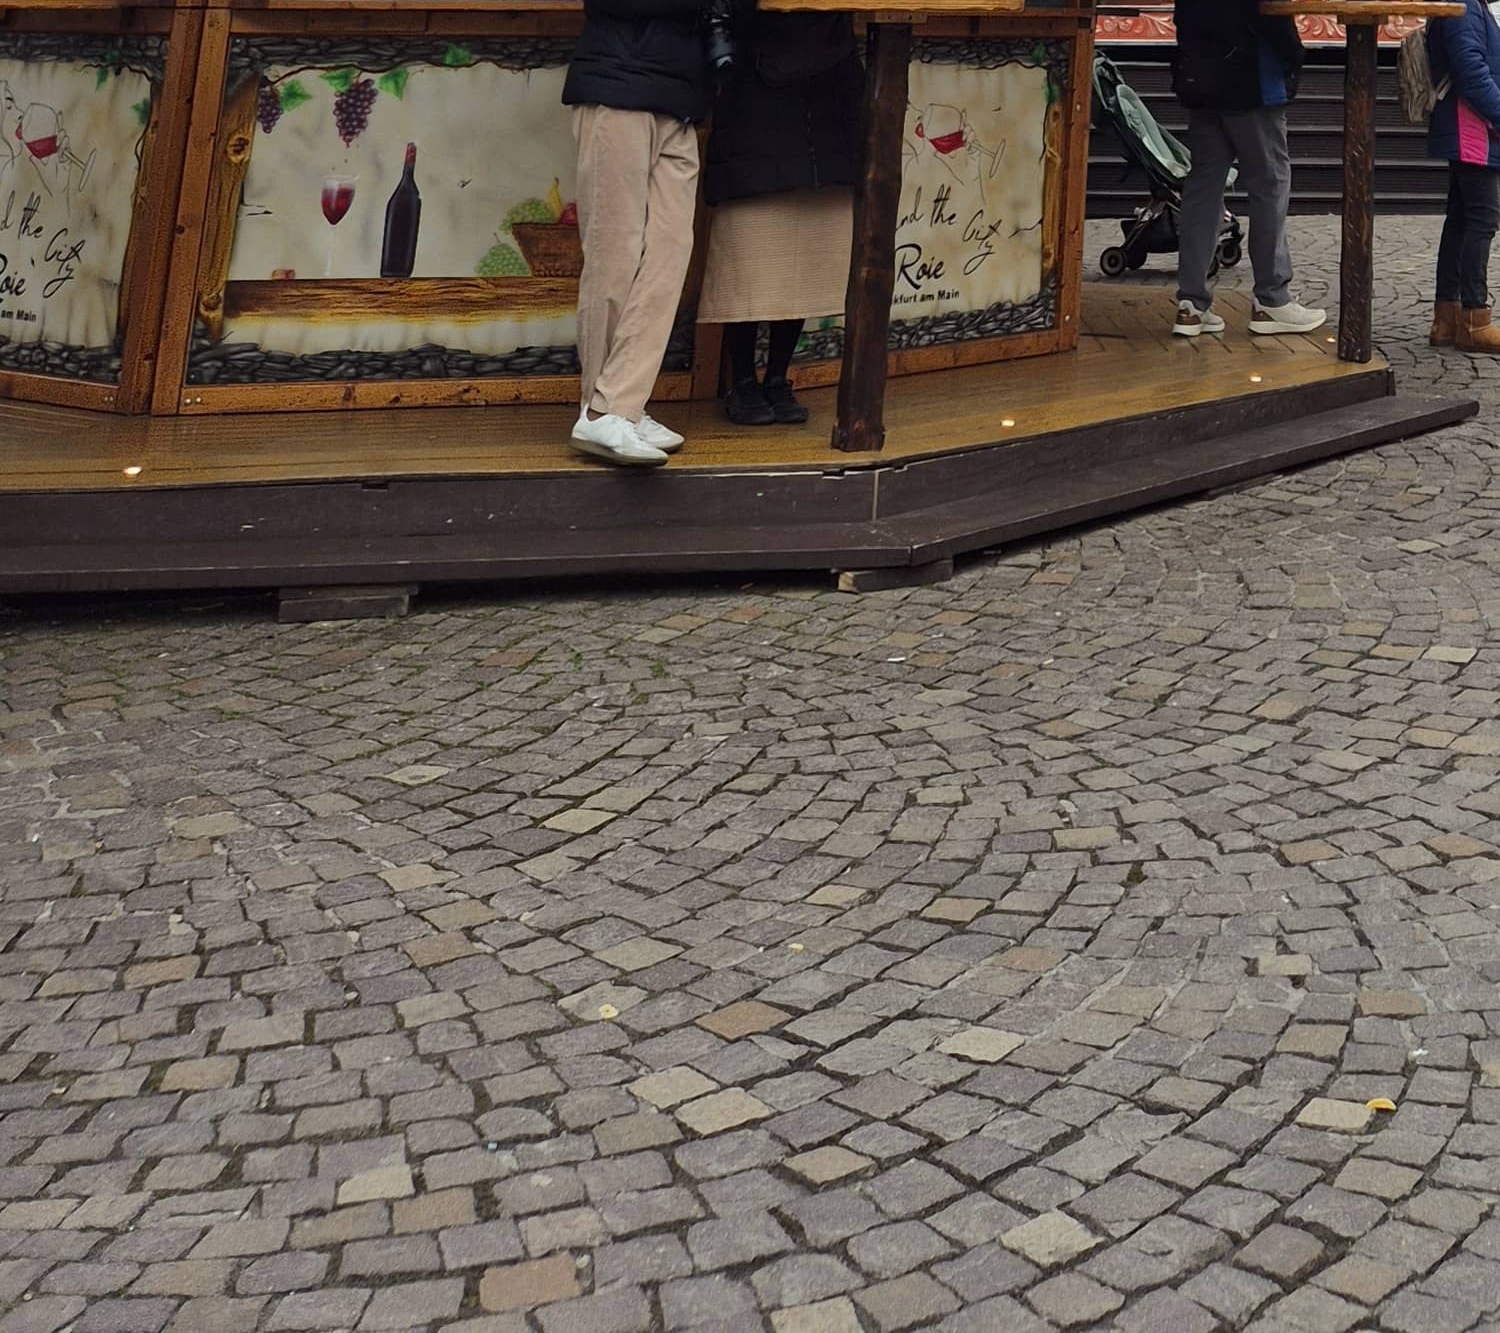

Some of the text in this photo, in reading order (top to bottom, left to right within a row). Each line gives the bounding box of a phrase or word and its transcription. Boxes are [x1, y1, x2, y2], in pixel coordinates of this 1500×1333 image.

[0, 190, 86, 298] d the City
[896, 183, 1002, 275] nd the City
[895, 244, 945, 290] Roie
[16, 309, 37, 322] Main
[893, 289, 960, 305] kfurt am Main
